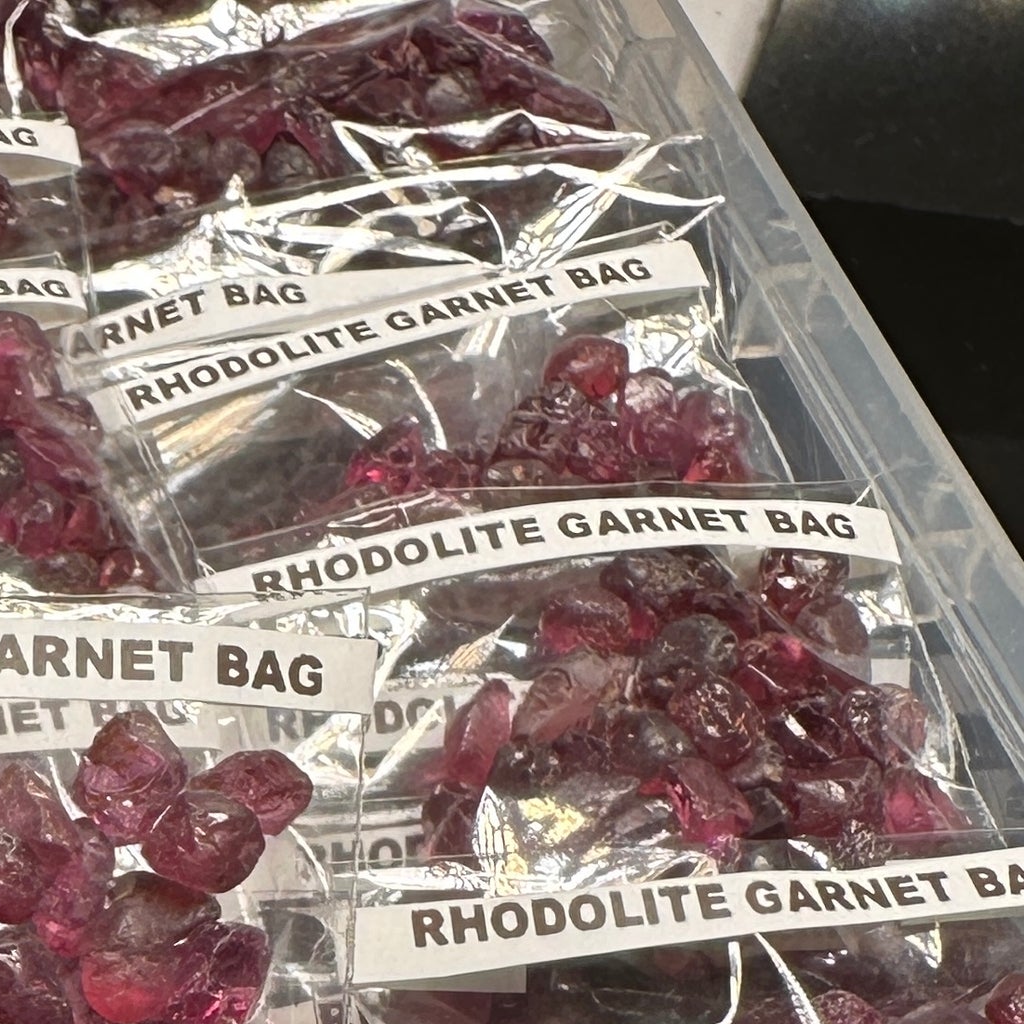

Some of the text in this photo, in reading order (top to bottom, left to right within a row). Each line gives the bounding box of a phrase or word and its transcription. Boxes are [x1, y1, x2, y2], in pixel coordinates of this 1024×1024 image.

[222, 283, 306, 307] BAG
[125, 258, 653, 410] RHODOLITE GARNET BAG
[252, 507, 856, 601] RHODOLITE GARNET BAG
[217, 643, 324, 696] BAG
[411, 883, 732, 948] RHODOLITE
[745, 871, 952, 915] GARNET
